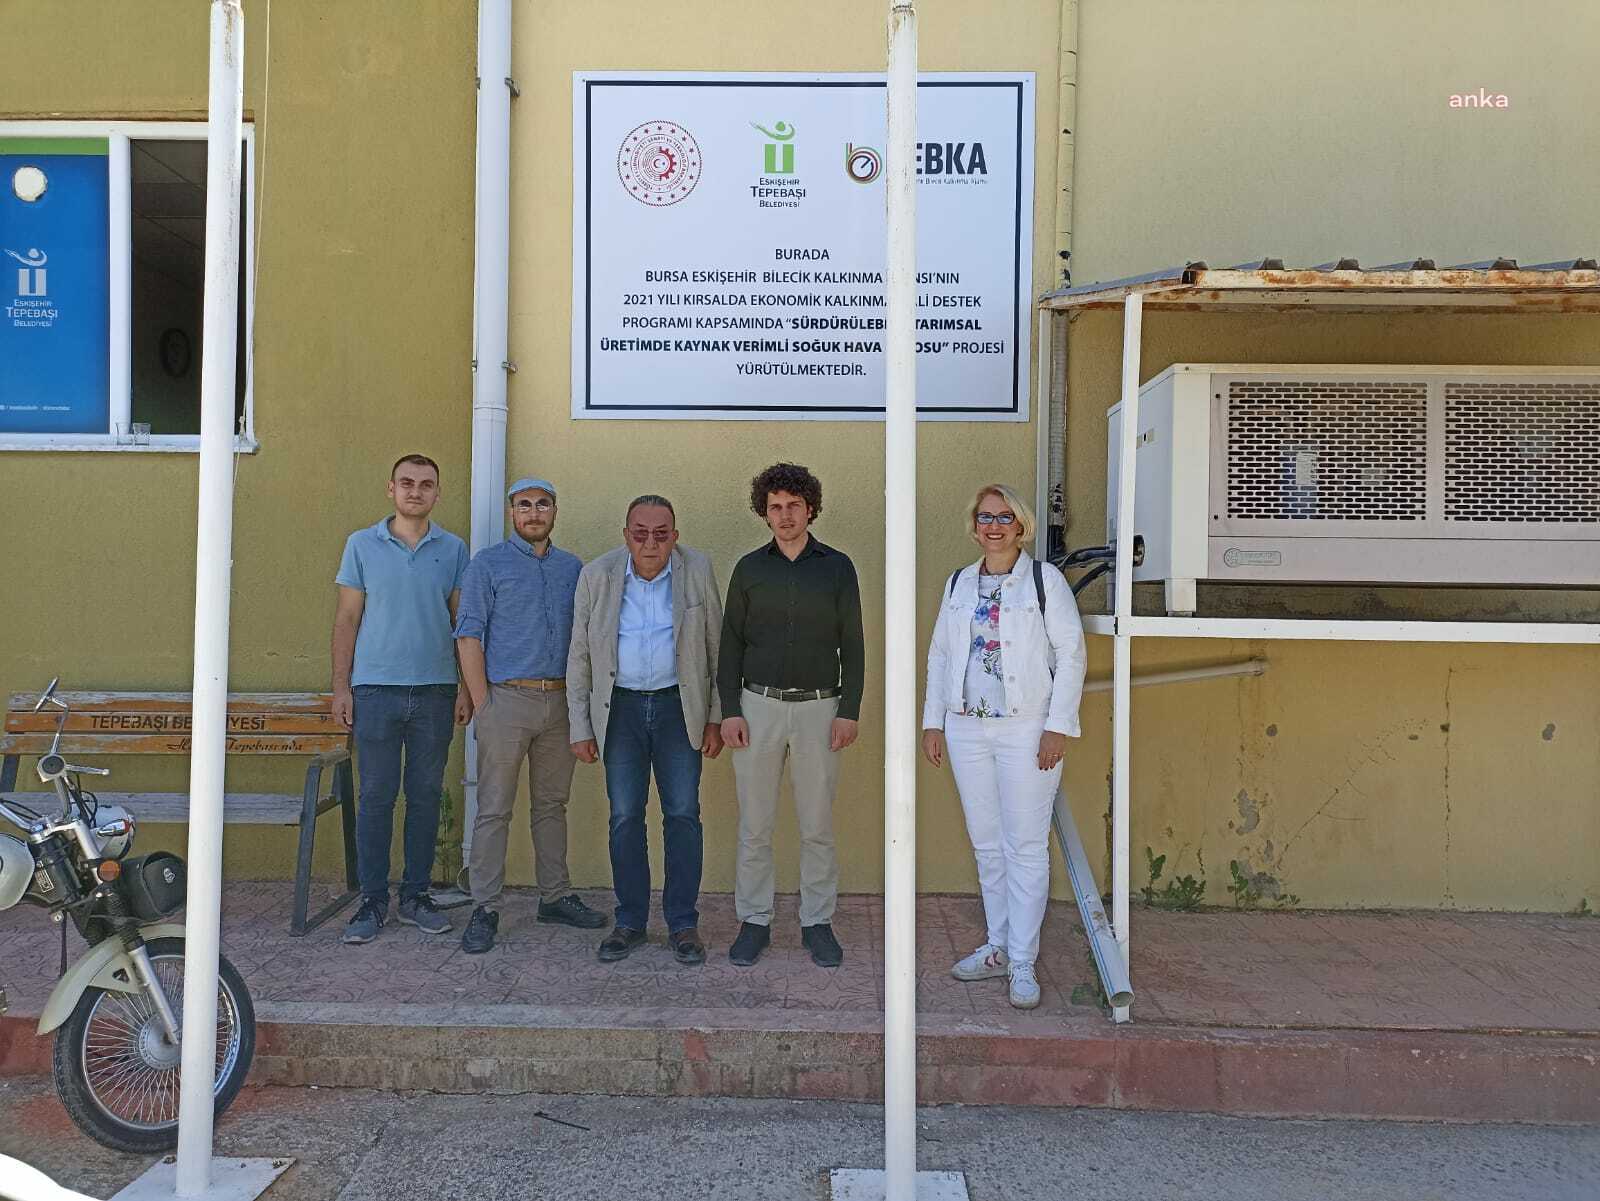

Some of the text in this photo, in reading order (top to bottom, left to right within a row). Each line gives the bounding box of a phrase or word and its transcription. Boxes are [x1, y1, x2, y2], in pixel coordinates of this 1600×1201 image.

[750, 185, 806, 200] TEPEBAŞI
[776, 249, 829, 260] BURADA
[646, 271, 688, 282] BURSA
[693, 270, 756, 285] ESKİŞEHİR
[763, 270, 810, 283] BİLECİK
[815, 272, 882, 283] KALKINMA
[624, 295, 652, 304] 2021
[658, 294, 679, 304] YILI
[684, 295, 747, 305] KIRSALDA
[751, 293, 821, 306] EKONOMİK
[825, 296, 887, 306] KALKINM
[933, 296, 981, 307] DESTEK
[623, 317, 691, 328] PROGRAMI
[696, 318, 783, 328] KAPSAMINDA
[916, 319, 982, 330] TARIMSAL
[601, 337, 671, 351] ÜRETİMDE
[675, 341, 730, 351] KAYNAK
[733, 339, 788, 352] VERİMLİ
[793, 339, 840, 352] SOĞUK
[845, 342, 882, 352] HAVA
[953, 340, 1004, 353] PROJESİ
[737, 362, 866, 375] YÜRÜTÜLMEKTEDİR.
[91, 714, 167, 732] TEPEBAŞI
